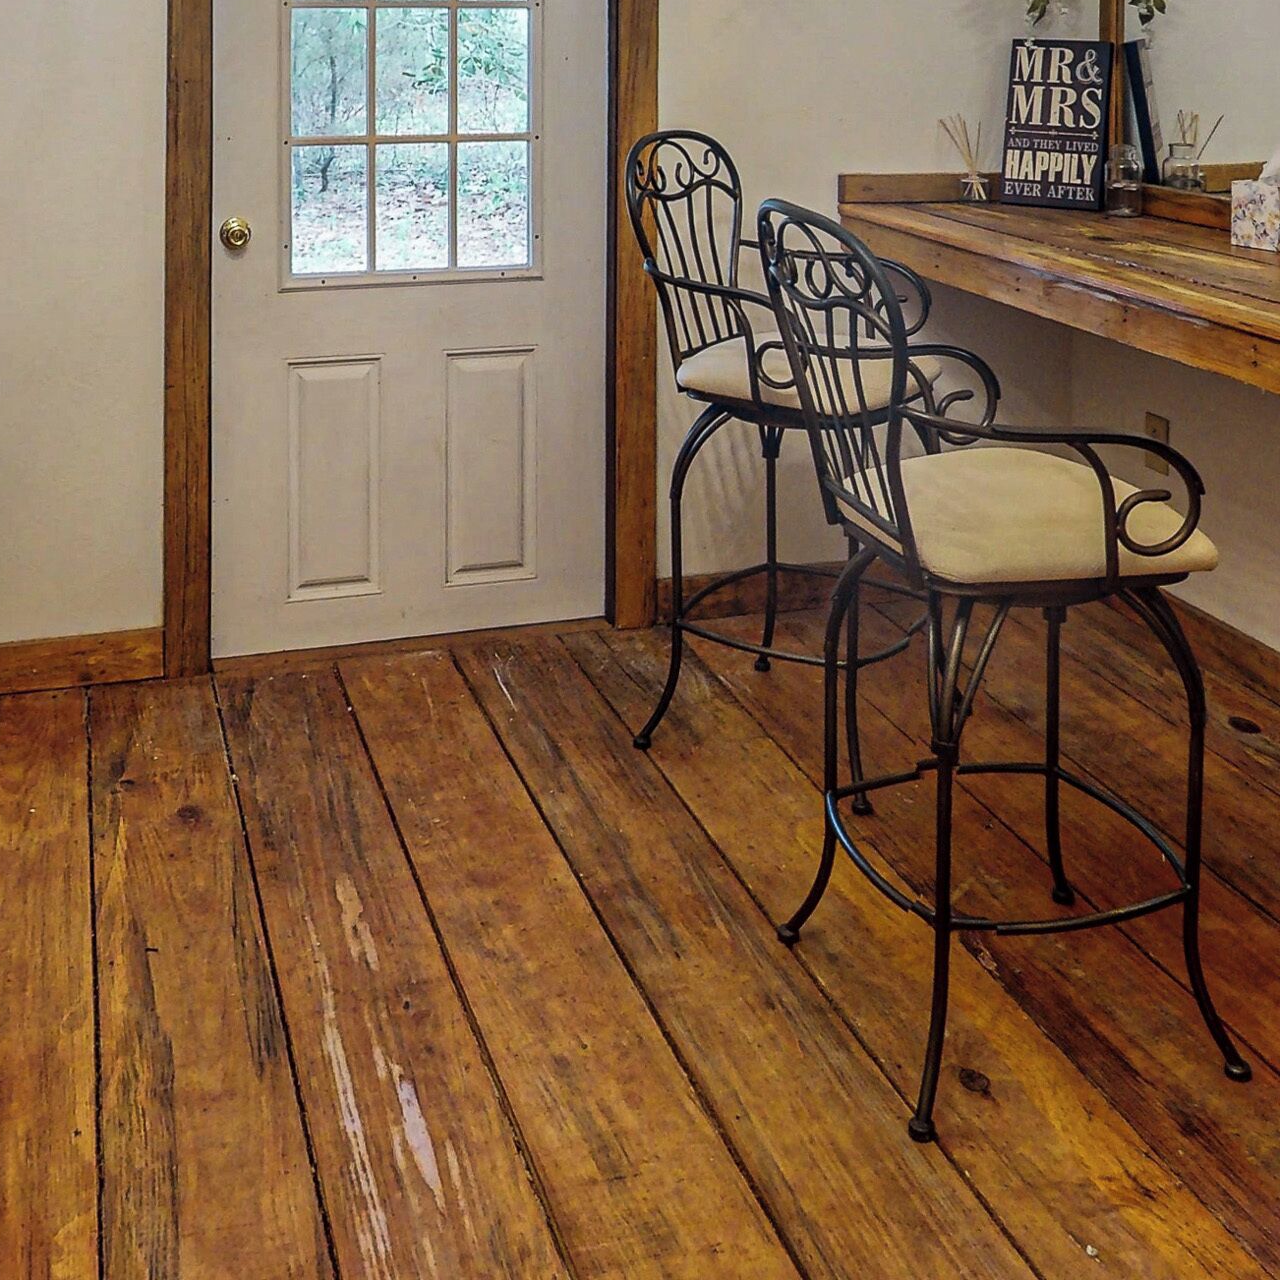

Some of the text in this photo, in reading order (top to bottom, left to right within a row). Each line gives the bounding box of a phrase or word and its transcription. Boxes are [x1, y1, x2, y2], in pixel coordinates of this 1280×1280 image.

[1009, 84, 1104, 129] MRS
[1007, 137, 1099, 153] AND THEY LIVED
[1005, 149, 1098, 185] HAPPILY
[1004, 181, 1095, 202] EVER AFTER
